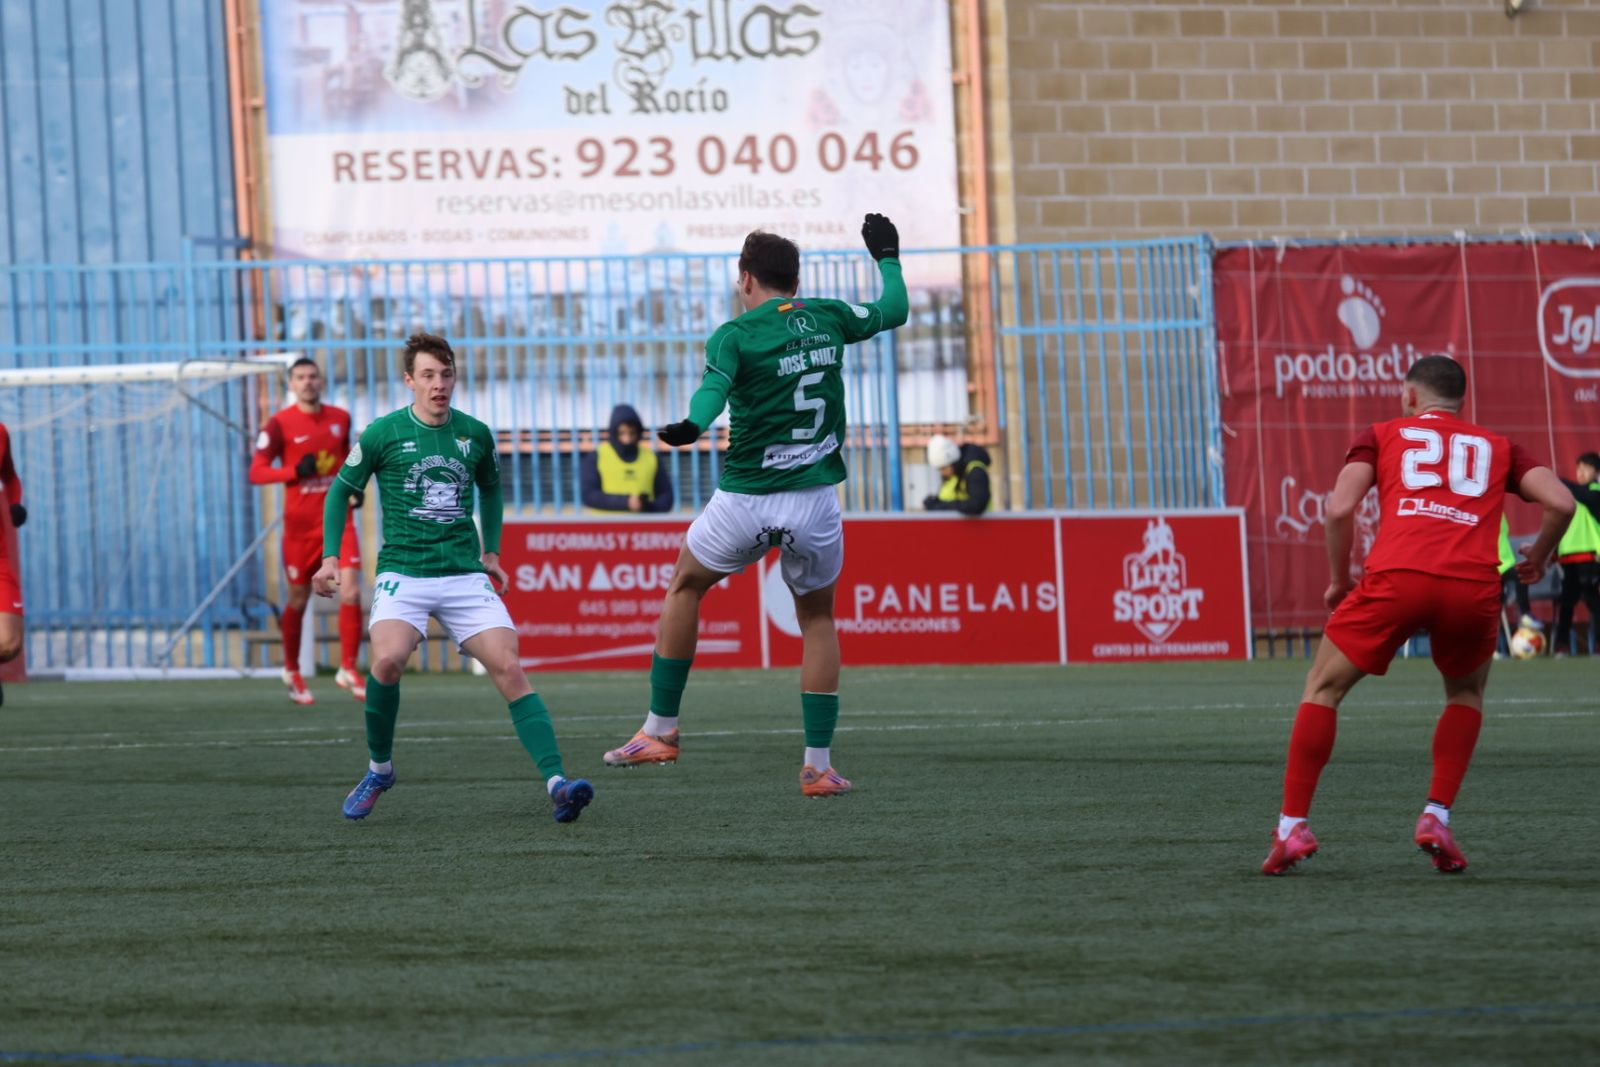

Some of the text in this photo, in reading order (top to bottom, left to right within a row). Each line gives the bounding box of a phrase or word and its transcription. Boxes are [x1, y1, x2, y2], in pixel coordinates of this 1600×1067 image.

[457, 0, 597, 82] Las
[564, 77, 728, 115] del Rocío
[333, 130, 920, 183] RESERVAS: 923 040 046
[436, 183, 822, 216] reservas@mesonlasvillas.es
[422, 229, 472, 244] BODAS
[488, 226, 590, 243] COMUNIONES
[805, 221, 848, 236] PARA
[786, 333, 831, 351] EL RUBIO
[777, 346, 837, 377] JOSÉ RUIZ
[1275, 343, 1452, 398] podoacti
[792, 372, 826, 440] 5
[1400, 426, 1492, 497] 20
[1417, 498, 1479, 523] Limcasa
[526, 532, 616, 550] REFORMAS
[617, 532, 629, 550] Y
[516, 563, 582, 591] SAN
[1130, 562, 1180, 591] LIFE
[854, 582, 1058, 619] PANELAIS
[1112, 587, 1204, 622] SPORT
[1133, 643, 1147, 656] DE
